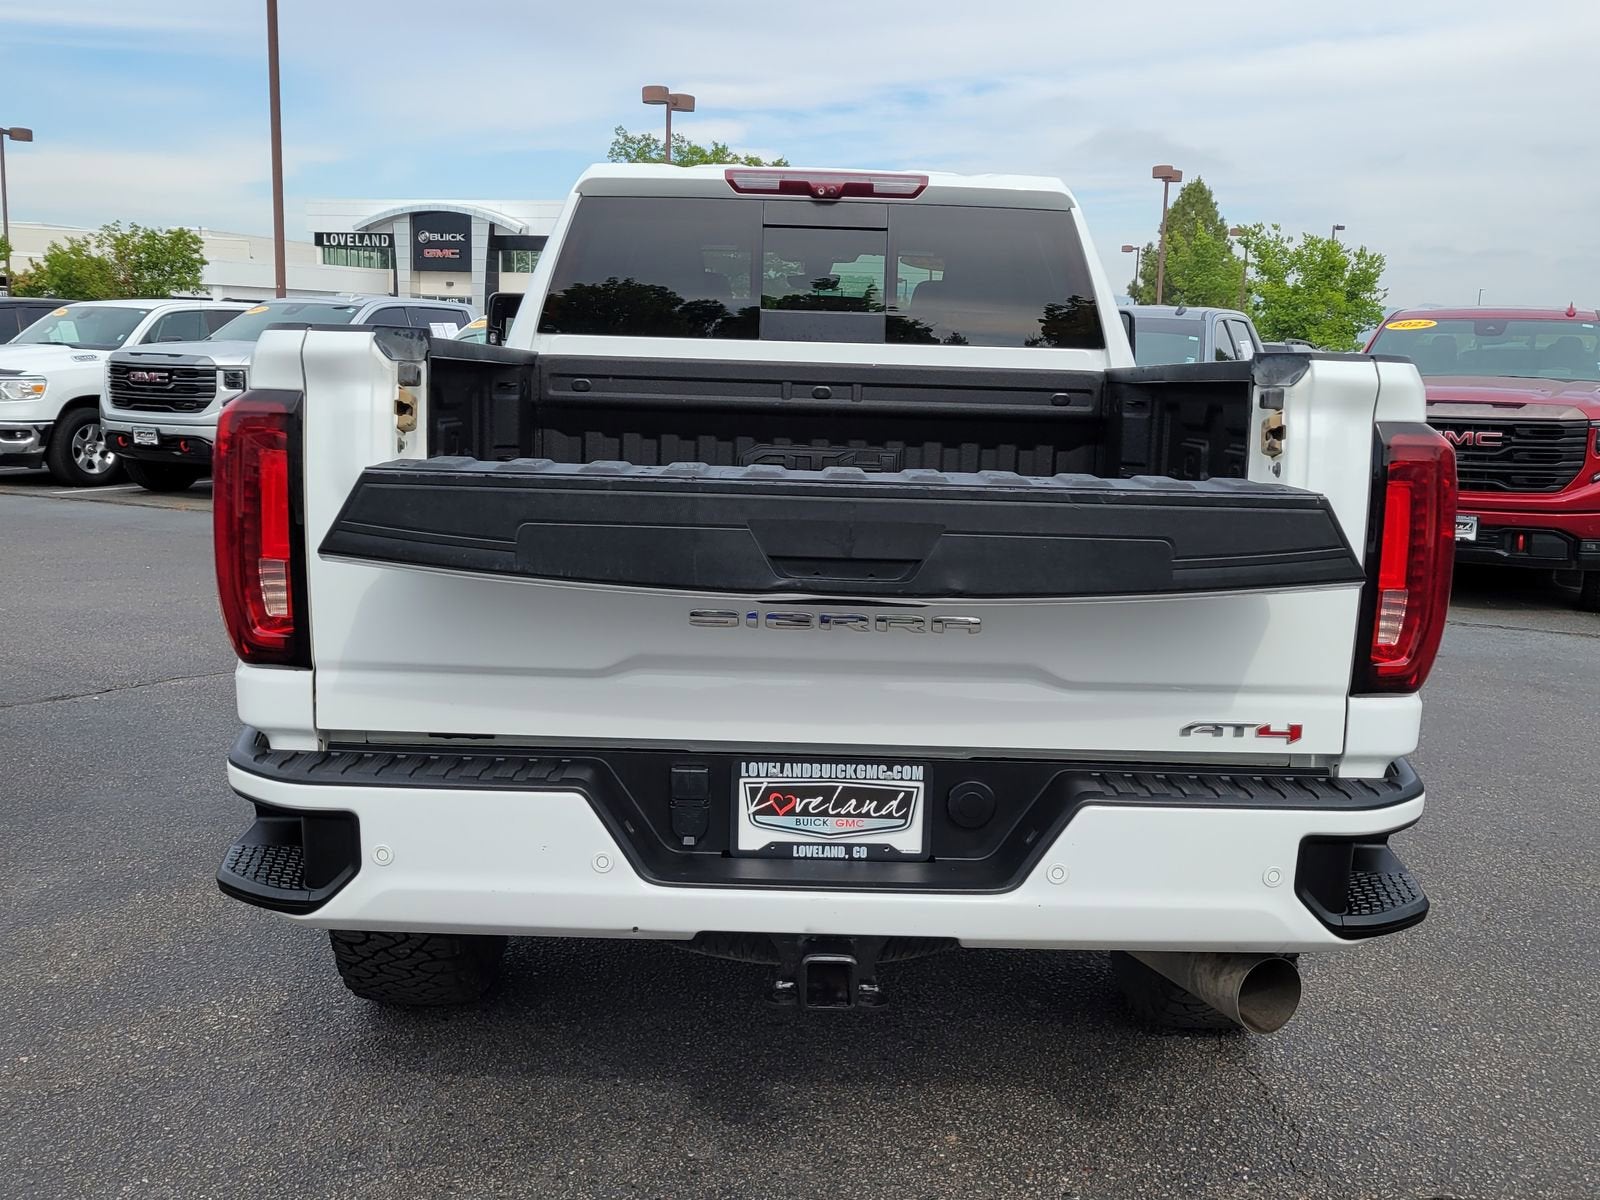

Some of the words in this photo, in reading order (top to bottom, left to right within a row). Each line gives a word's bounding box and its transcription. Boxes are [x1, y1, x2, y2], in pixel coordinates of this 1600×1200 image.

[323, 233, 390, 247] LOVELAND
[429, 232, 466, 242] BUICK
[423, 248, 460, 259] GMC
[128, 371, 169, 383] GMC
[1437, 430, 1503, 447] MC
[689, 608, 982, 635] SIERRA
[1179, 720, 1303, 745] AT4
[740, 762, 924, 781] LOVELANDBUICKGMCCOM
[795, 818, 829, 827] BUICK
[835, 819, 865, 828] GMC
[792, 845, 849, 860] LOVELAND,
[852, 846, 868, 859] CO
